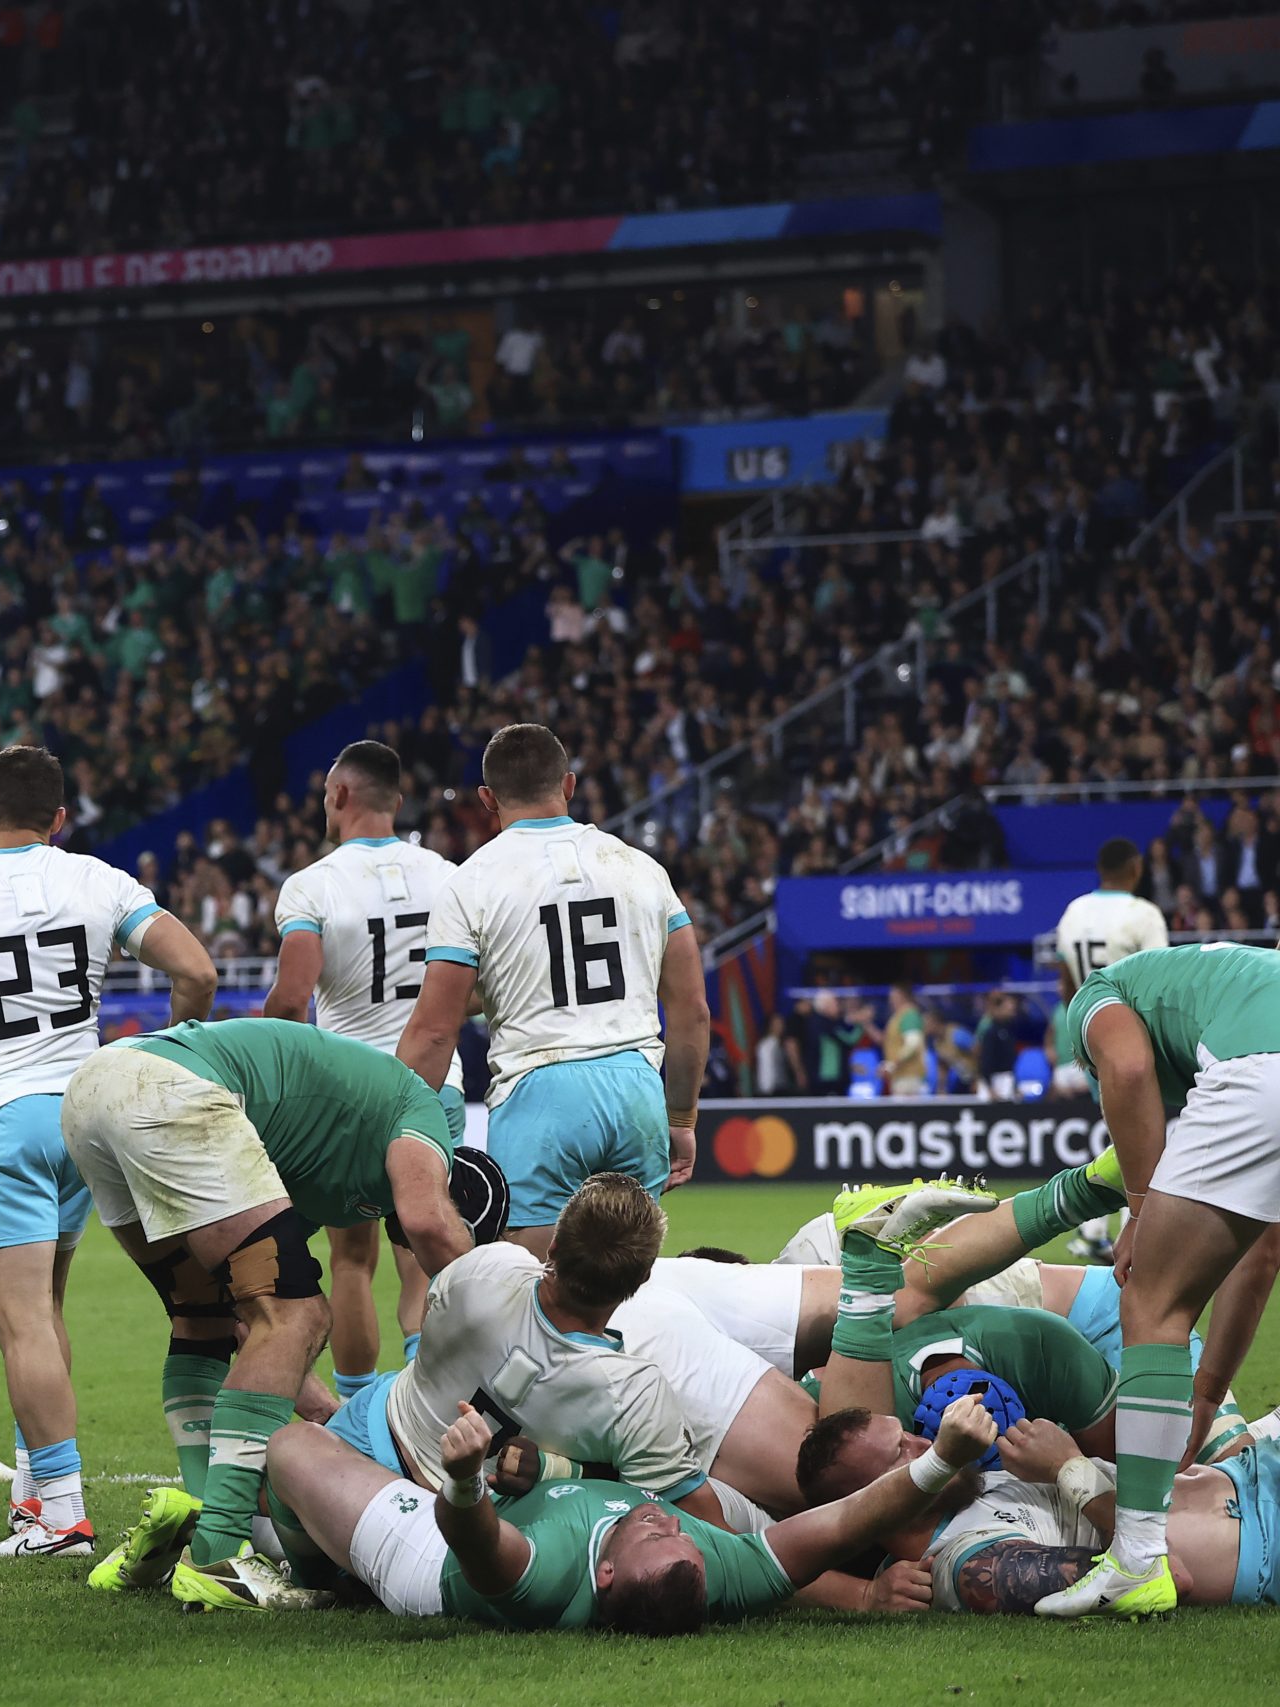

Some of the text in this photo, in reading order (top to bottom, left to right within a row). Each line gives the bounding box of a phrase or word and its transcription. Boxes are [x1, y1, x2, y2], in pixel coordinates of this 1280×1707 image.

[733, 448, 787, 482] U6
[539, 897, 625, 1007] 16
[813, 1108, 1113, 1170] masterc
